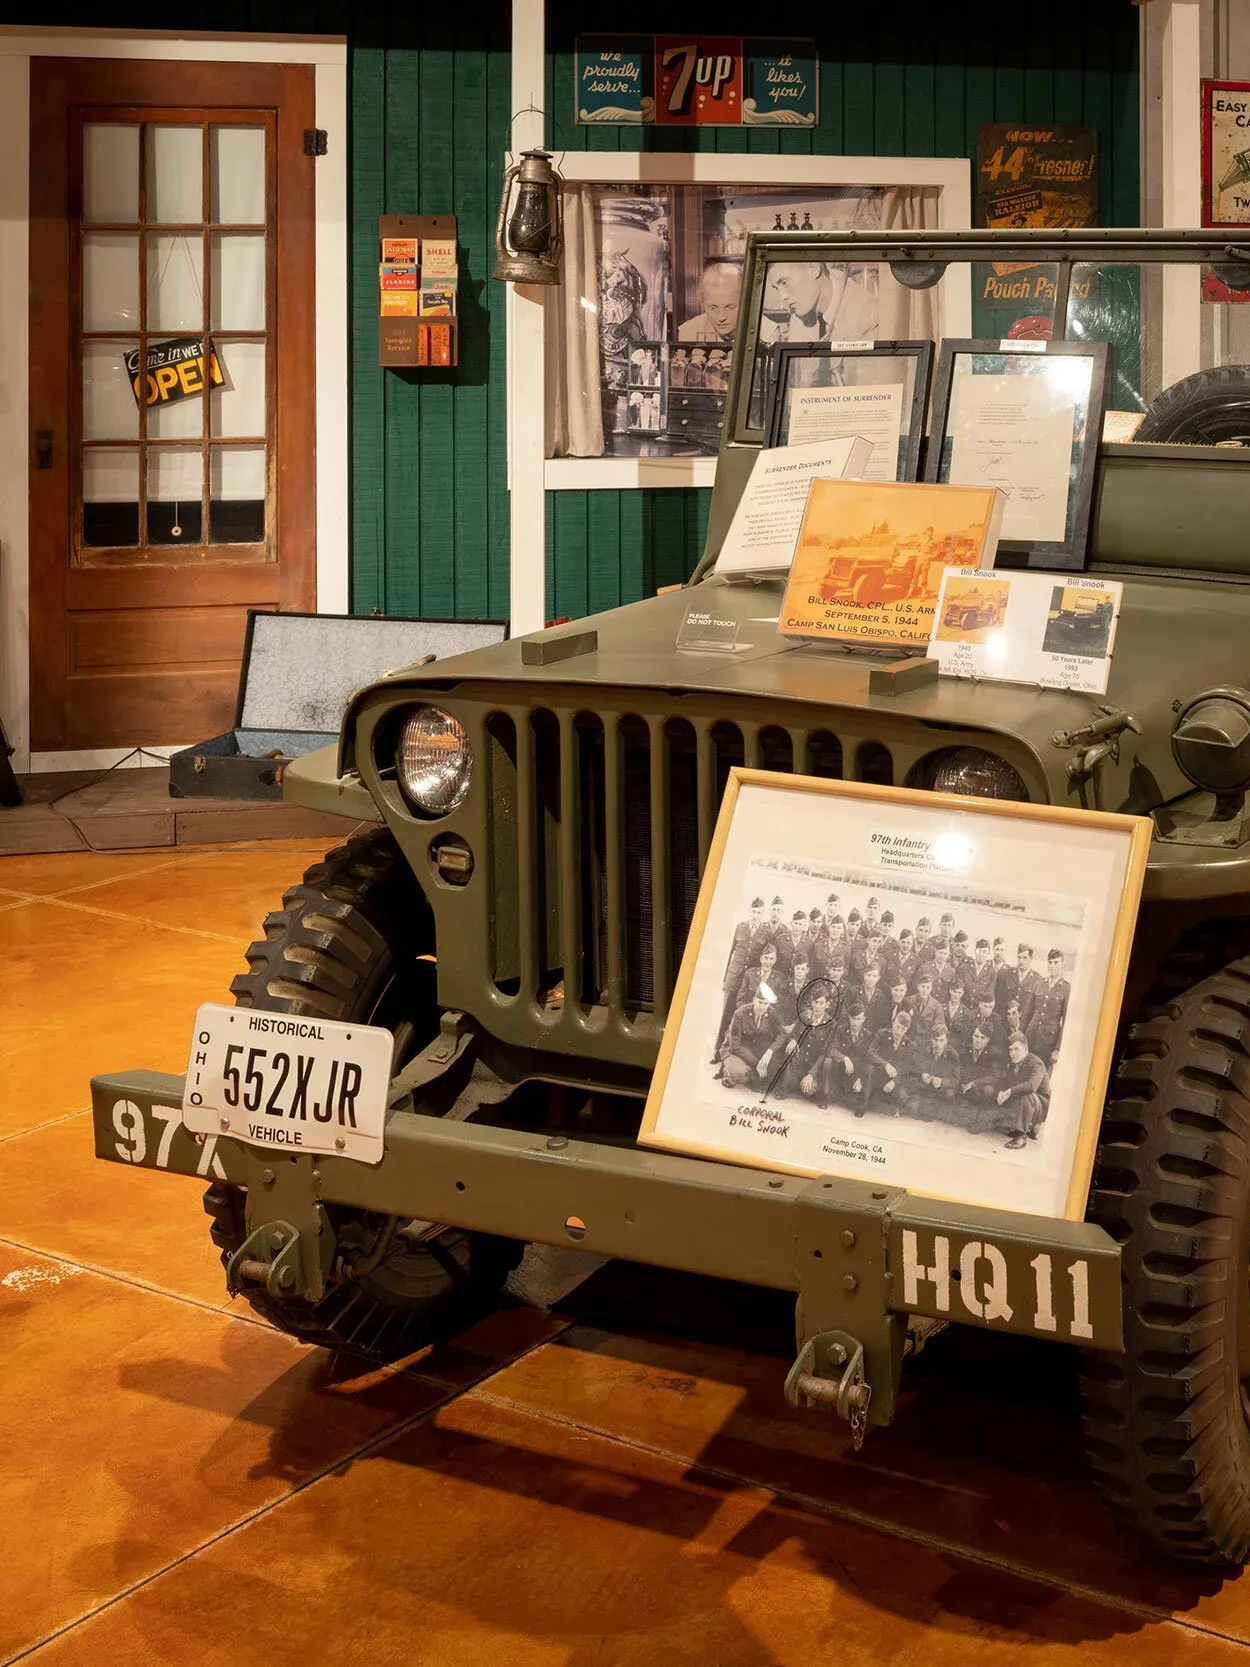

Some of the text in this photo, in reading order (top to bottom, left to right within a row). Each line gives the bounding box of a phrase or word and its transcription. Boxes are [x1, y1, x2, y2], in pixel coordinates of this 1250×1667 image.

[600, 52, 621, 62] we
[583, 62, 640, 81] proudly
[766, 67, 803, 84] likes
[587, 80, 641, 94] serve...
[769, 85, 806, 103] you!
[1216, 101, 1247, 112] EASY
[995, 199, 1040, 216] RALEIGH
[983, 276, 1090, 299] Pouch Paed
[127, 342, 204, 370] Cme in WE'
[134, 353, 223, 404] OPEN
[800, 396, 841, 405] INSTRUMENT
[853, 394, 892, 402] SURRENDER
[764, 459, 833, 475] SURRENDER DOCUMENTS
[960, 568, 997, 578] Bill Snook
[1066, 578, 1106, 589] Bill Snook
[807, 596, 827, 606] BILL
[830, 598, 864, 610] SNOOK,
[895, 603, 914, 613] U.S.
[688, 612, 711, 620] PLEASE
[697, 619, 712, 627] NOT
[713, 620, 737, 628] TOUCH
[824, 609, 919, 627] SEPTEMBER 5, 1944
[787, 618, 814, 629] CAMP
[815, 620, 835, 631] SAN
[836, 622, 859, 634] LUIS
[861, 626, 898, 638] OBISPO,
[870, 833, 931, 852] 97th Infantry
[881, 847, 925, 859] Headquarters
[881, 857, 932, 869] Transportation
[249, 1017, 325, 1041] HISTORICAL
[190, 1030, 211, 1106] OHIO
[223, 1044, 363, 1128] 552XJR
[737, 1105, 785, 1122] CORPORAL
[248, 1123, 302, 1145] VEHICLE
[729, 1114, 791, 1138] BILL SNOOK
[830, 1137, 883, 1153] Camp Cook, CA
[822, 1145, 886, 1165] November 28, 1944
[902, 1229, 1094, 1339] HQ 11
